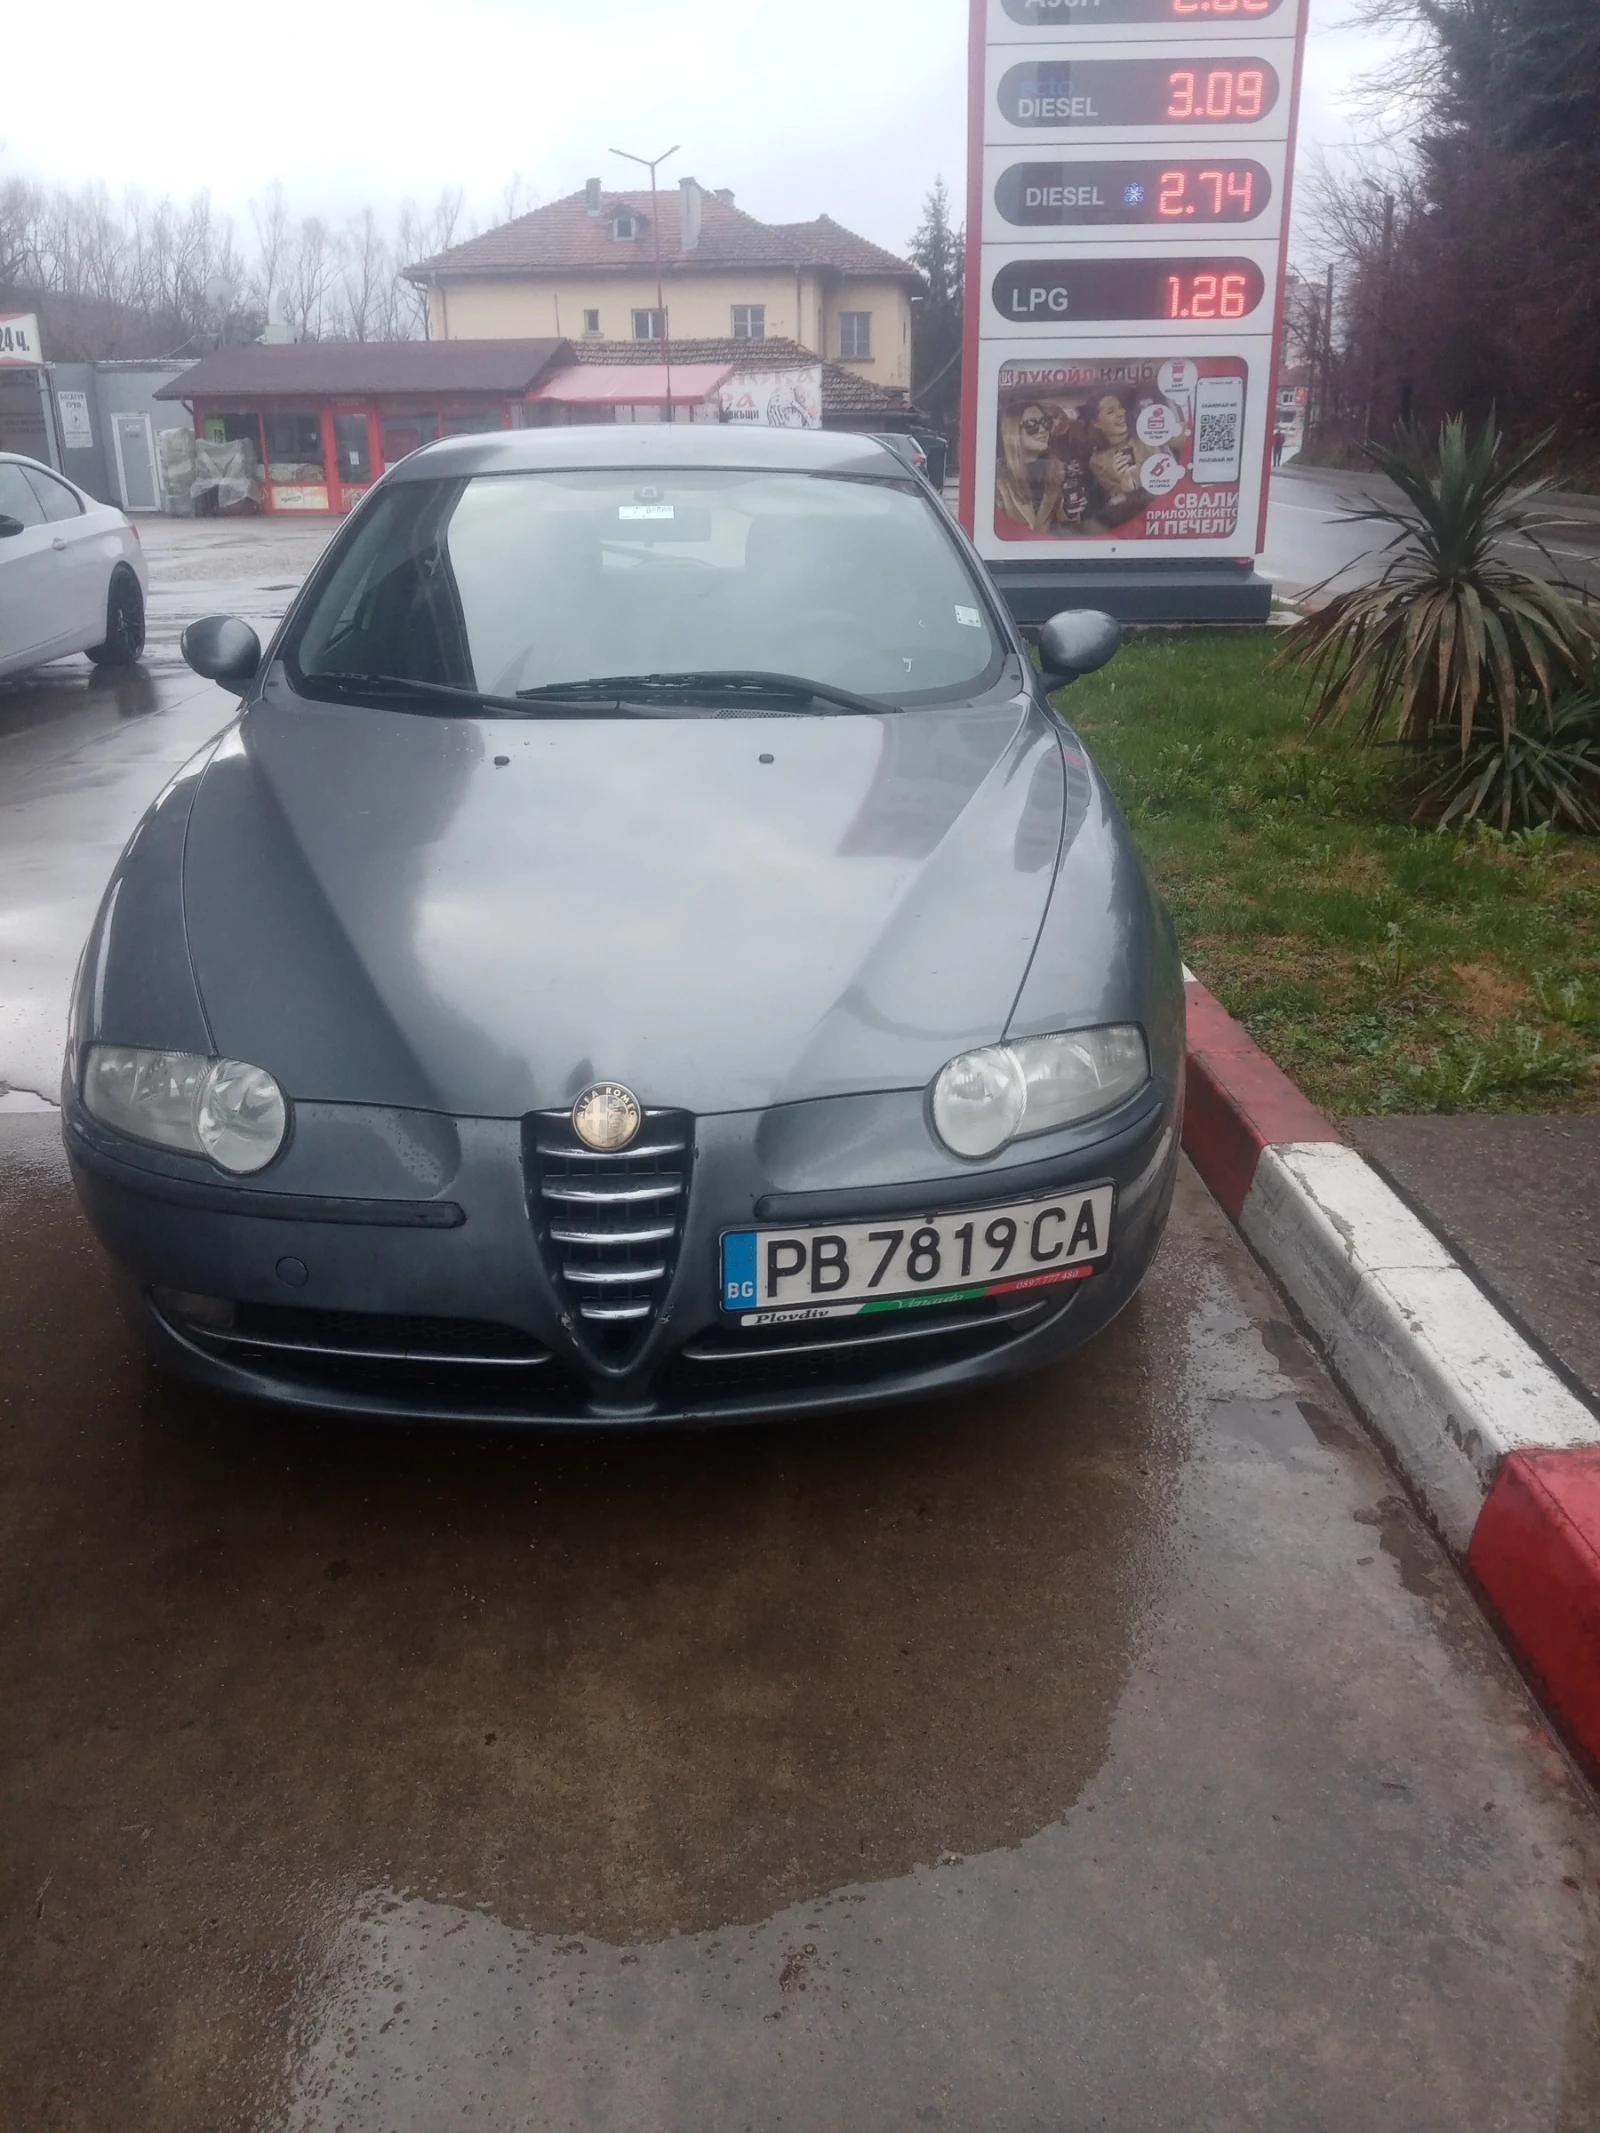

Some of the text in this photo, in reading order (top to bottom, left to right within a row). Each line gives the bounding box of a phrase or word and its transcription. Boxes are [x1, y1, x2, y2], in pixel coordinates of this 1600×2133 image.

[1167, 71, 1264, 117] 3.09
[1017, 97, 1099, 118] DIESEL
[1025, 186, 1105, 207] DIESEL
[1158, 171, 1253, 215] 2.74
[1012, 287, 1069, 312] LPG
[1168, 276, 1246, 318] 1.26
[1015, 366, 1096, 386] ЛУКОЙЛ
[1100, 361, 1154, 384] клуб
[1173, 492, 1239, 509] СВАЛИ
[1145, 519, 1237, 535] И ПЕЧЕЛИ
[577, 1087, 637, 1118] ALFA ROMEO
[727, 1281, 754, 1299] BG
[755, 1309, 829, 1325] Plovdiv
